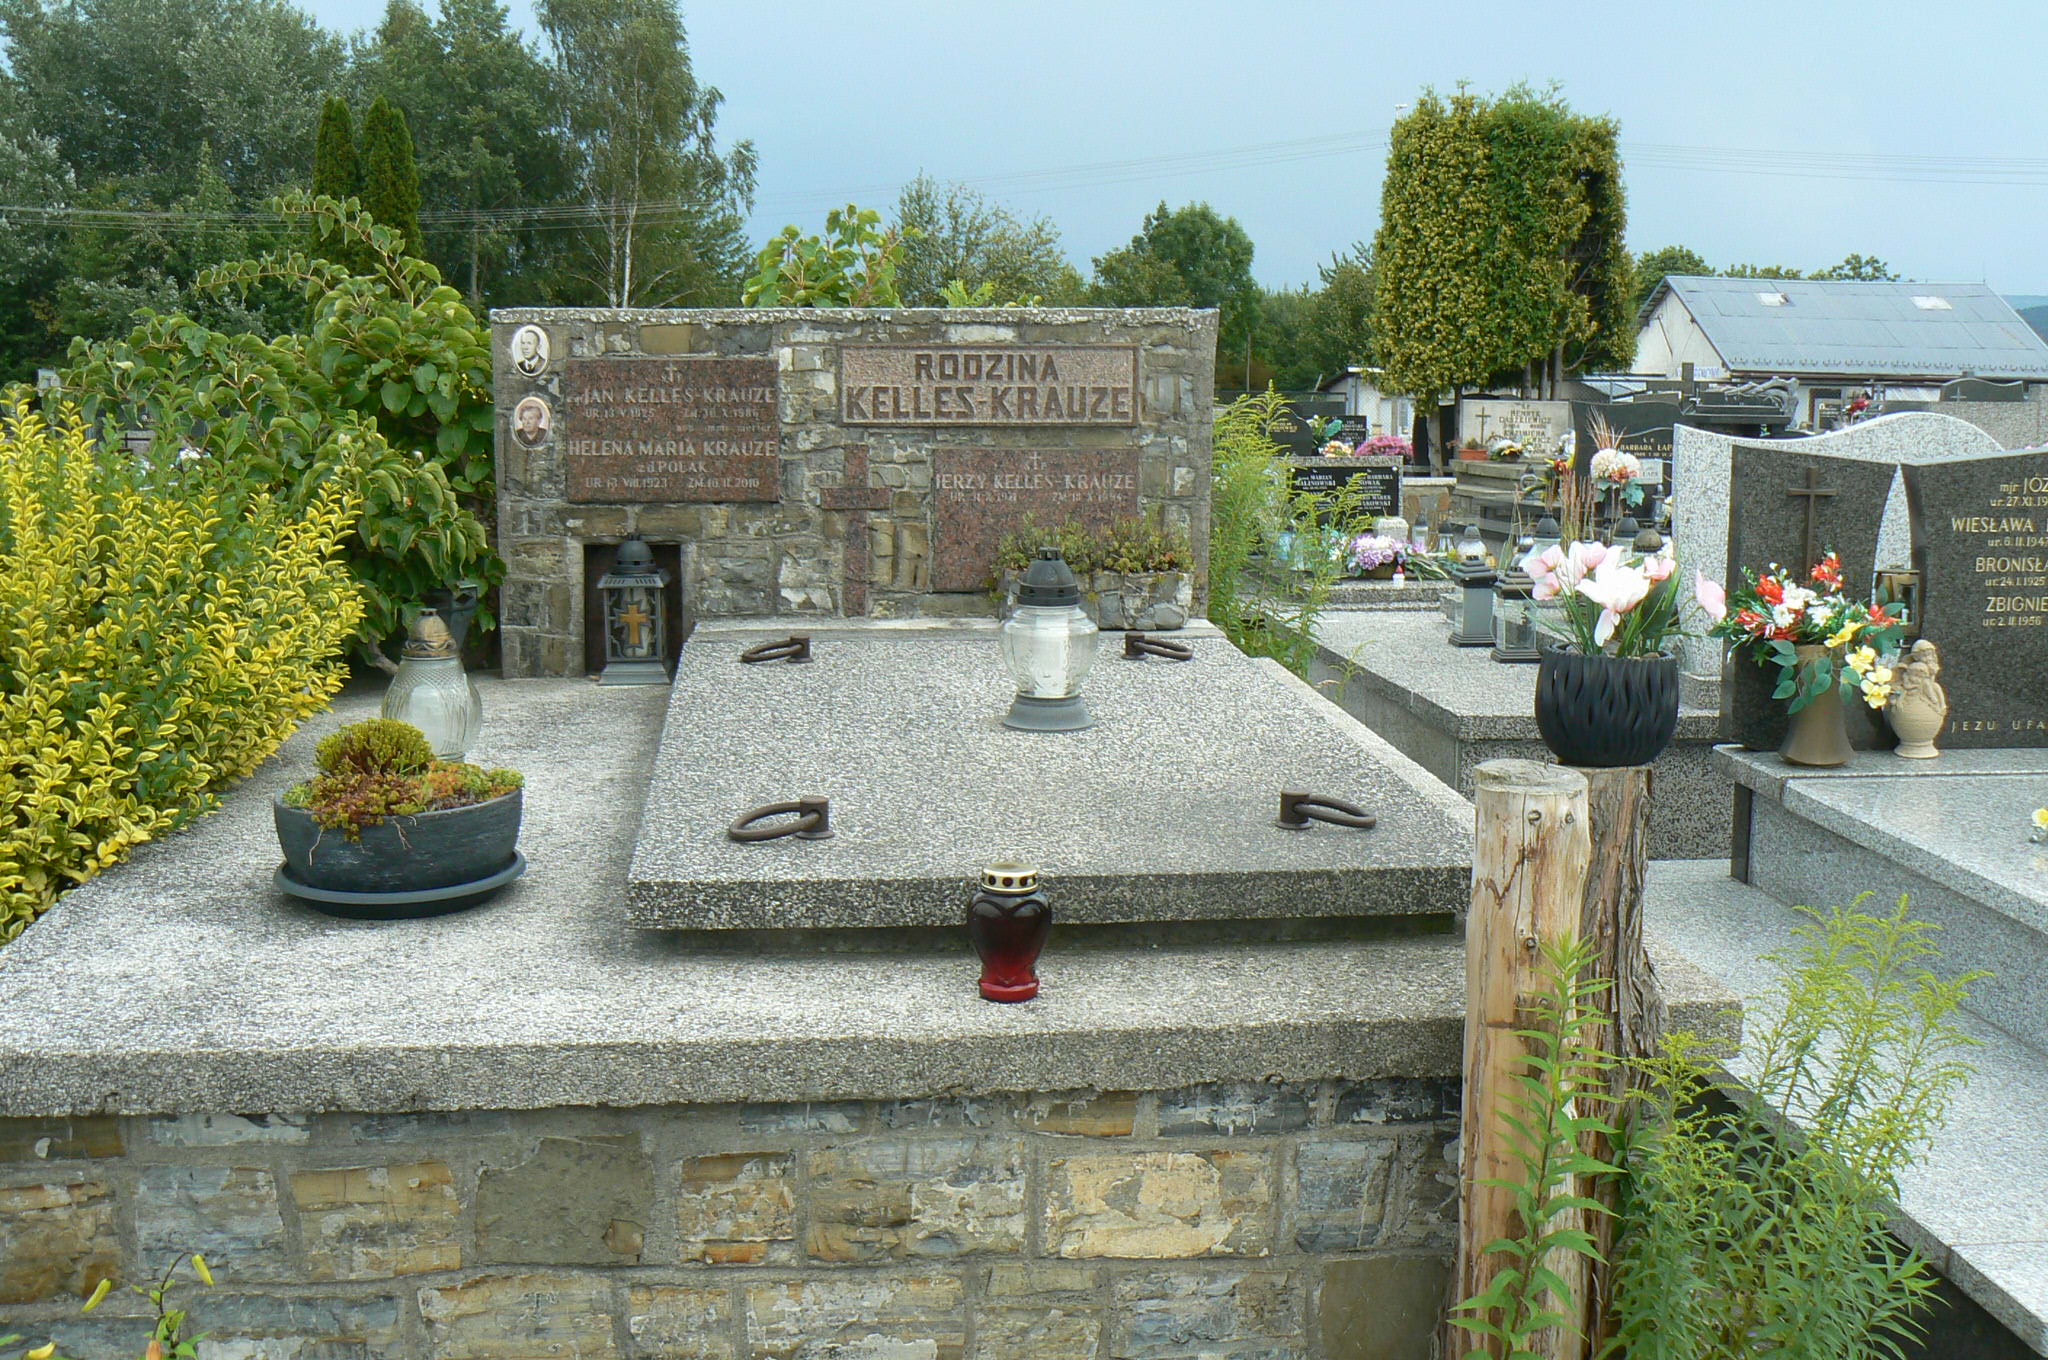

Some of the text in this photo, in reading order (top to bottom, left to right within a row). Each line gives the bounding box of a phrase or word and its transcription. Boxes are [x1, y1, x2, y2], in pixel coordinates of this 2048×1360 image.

[915, 353, 1059, 381] RODZINA
[583, 388, 614, 404] JAN
[624, 387, 775, 404] KELLES-KRAUZE
[846, 385, 1129, 419] KELLES-KRAUZE
[569, 440, 776, 457] HELENA MARIA KRAUZE
[658, 461, 712, 473] POLAK
[994, 474, 1136, 490] KELLES-KRAUZE
[2000, 482, 2019, 494] mjr
[1951, 517, 2034, 533] WIESŁAWA
[1985, 597, 2048, 613] ZBIGNIE
[1952, 721, 1995, 733] JEZU
